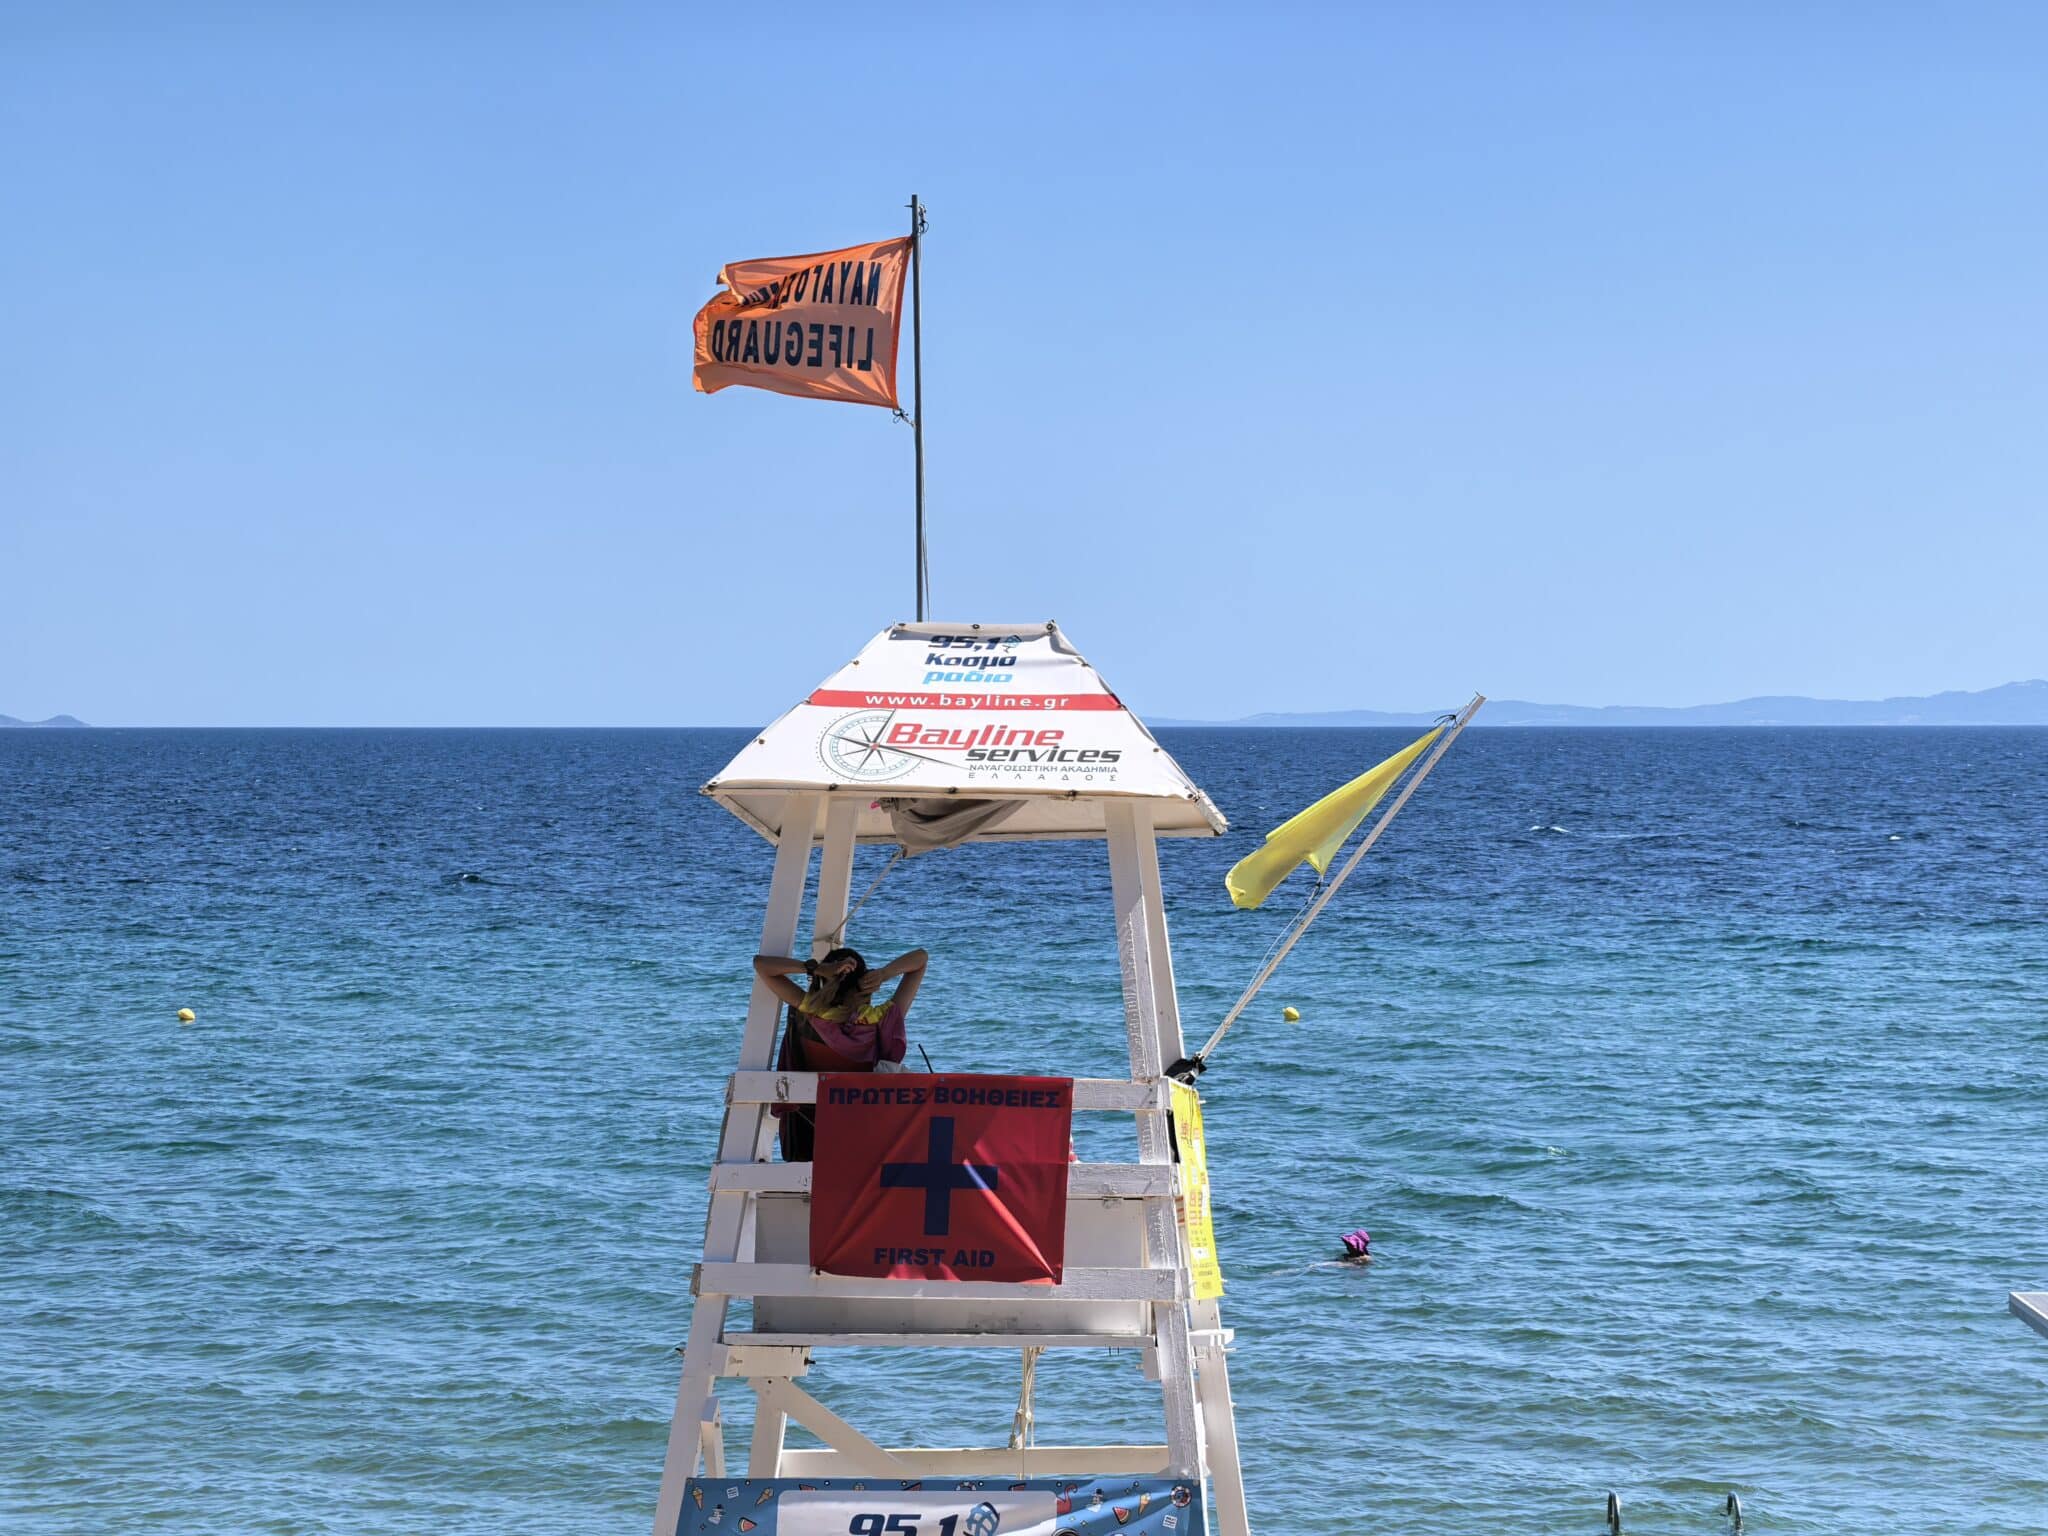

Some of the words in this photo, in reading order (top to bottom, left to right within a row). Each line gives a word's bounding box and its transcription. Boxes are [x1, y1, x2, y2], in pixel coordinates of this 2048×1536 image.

[928, 635, 1002, 652] 95,1
[865, 693, 1070, 709] www.bayline.gr
[886, 723, 1064, 749] Bayline
[965, 746, 1121, 763] services
[969, 764, 1057, 773] ΝΑΥΑΓΟΣΩΣΤΙΚΗ
[1060, 765, 1118, 773] ΑΚΑΔΗΜΙΑ
[829, 1087, 930, 1105] ΠΡΩΤΕΣ
[934, 1087, 1060, 1108] ΒΟΗΘΕΙΕΣ
[873, 1247, 945, 1267] FIRST
[952, 1248, 995, 1268] AID
